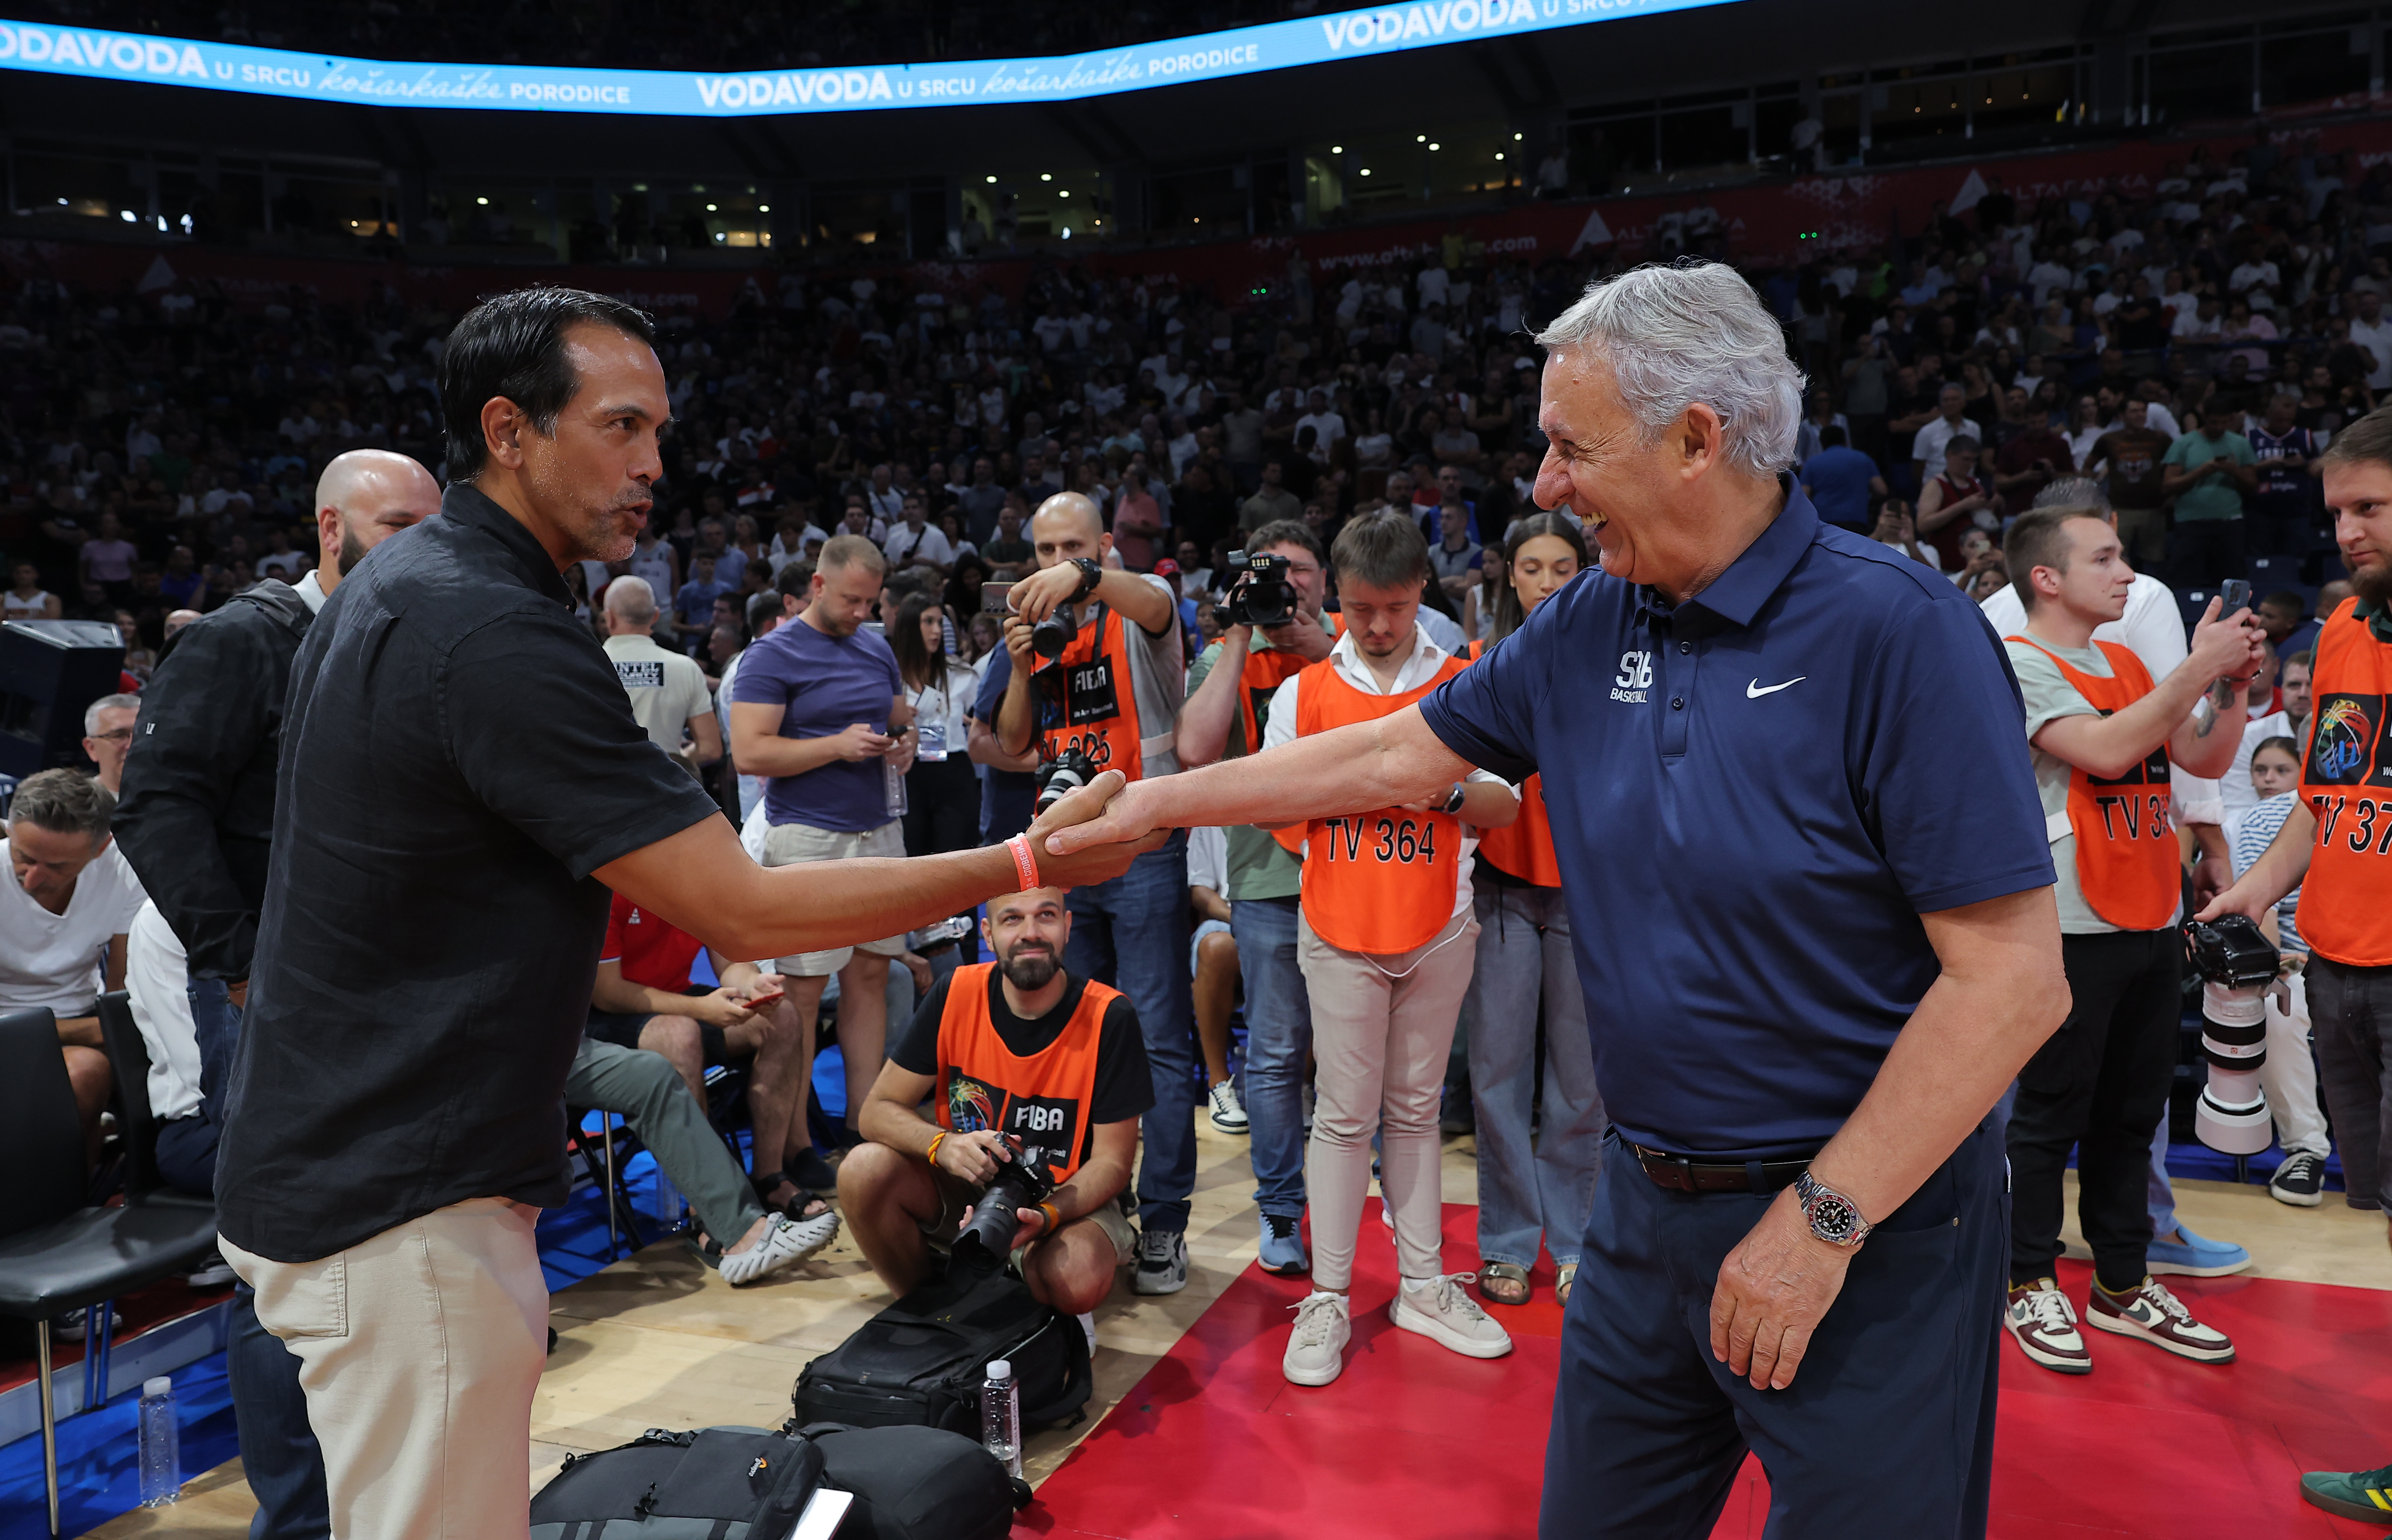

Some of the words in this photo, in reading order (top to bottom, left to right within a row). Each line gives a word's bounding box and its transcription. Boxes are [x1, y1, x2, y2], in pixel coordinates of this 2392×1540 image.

[1323, 0, 1536, 50] VODAVODA
[215, 61, 234, 79] U
[242, 64, 311, 88] SRCU
[318, 62, 504, 99] košarkaške
[510, 82, 631, 104] PORODICE
[696, 71, 893, 108] VODAVODA
[898, 80, 913, 98] U
[919, 78, 975, 97] SRCU
[981, 51, 1143, 96] košarkaške
[1148, 43, 1258, 77] PORODICE
[2096, 794, 2140, 840] TV
[1013, 839, 1033, 877] СЛОВЕНИЈА
[1326, 818, 1364, 862] TV
[1374, 818, 1435, 865] 364
[1014, 1105, 1064, 1131] FIBA
